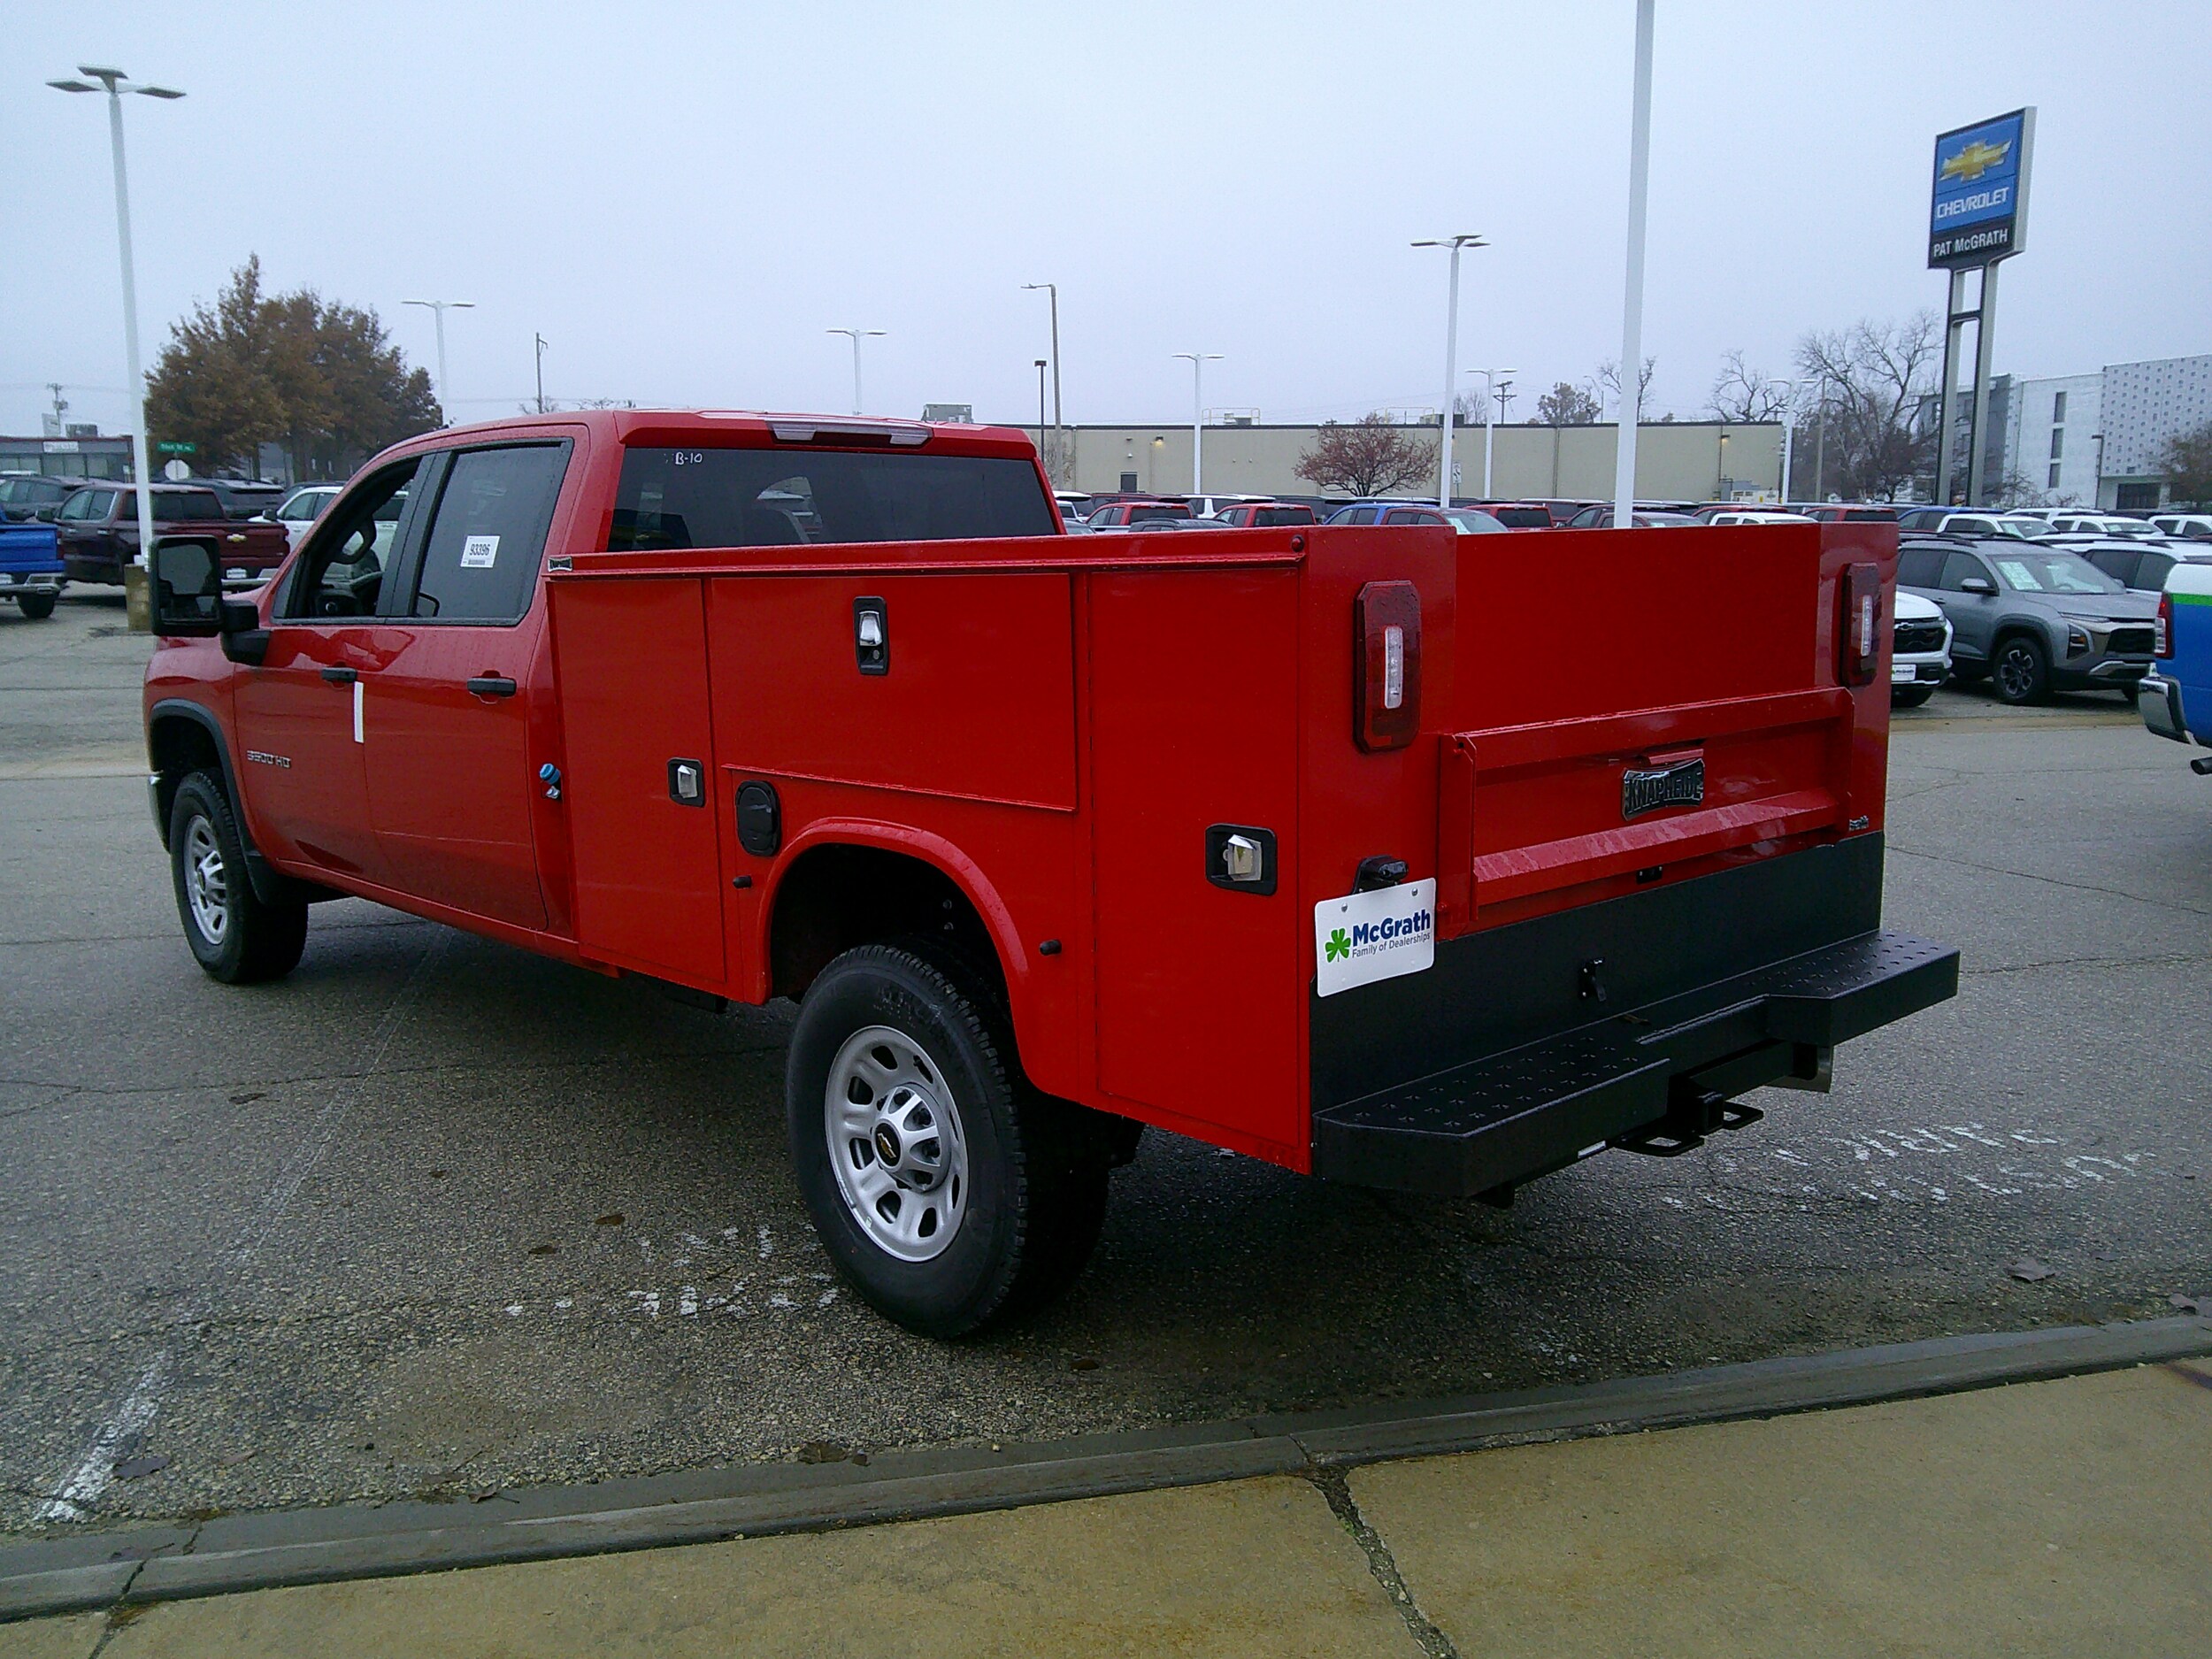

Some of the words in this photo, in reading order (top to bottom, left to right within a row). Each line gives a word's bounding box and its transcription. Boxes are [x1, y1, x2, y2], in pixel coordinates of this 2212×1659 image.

[1937, 187, 2009, 219] CHEVROLET
[1933, 241, 1952, 257] PAT
[1955, 228, 2008, 251] McGRATH
[675, 451, 703, 465] B-10
[469, 543, 491, 556] 93396
[1353, 910, 1431, 947] McGrath
[1352, 945, 1377, 958] Family
[1379, 942, 1387, 952] of
[1389, 932, 1431, 949] Dealerships
